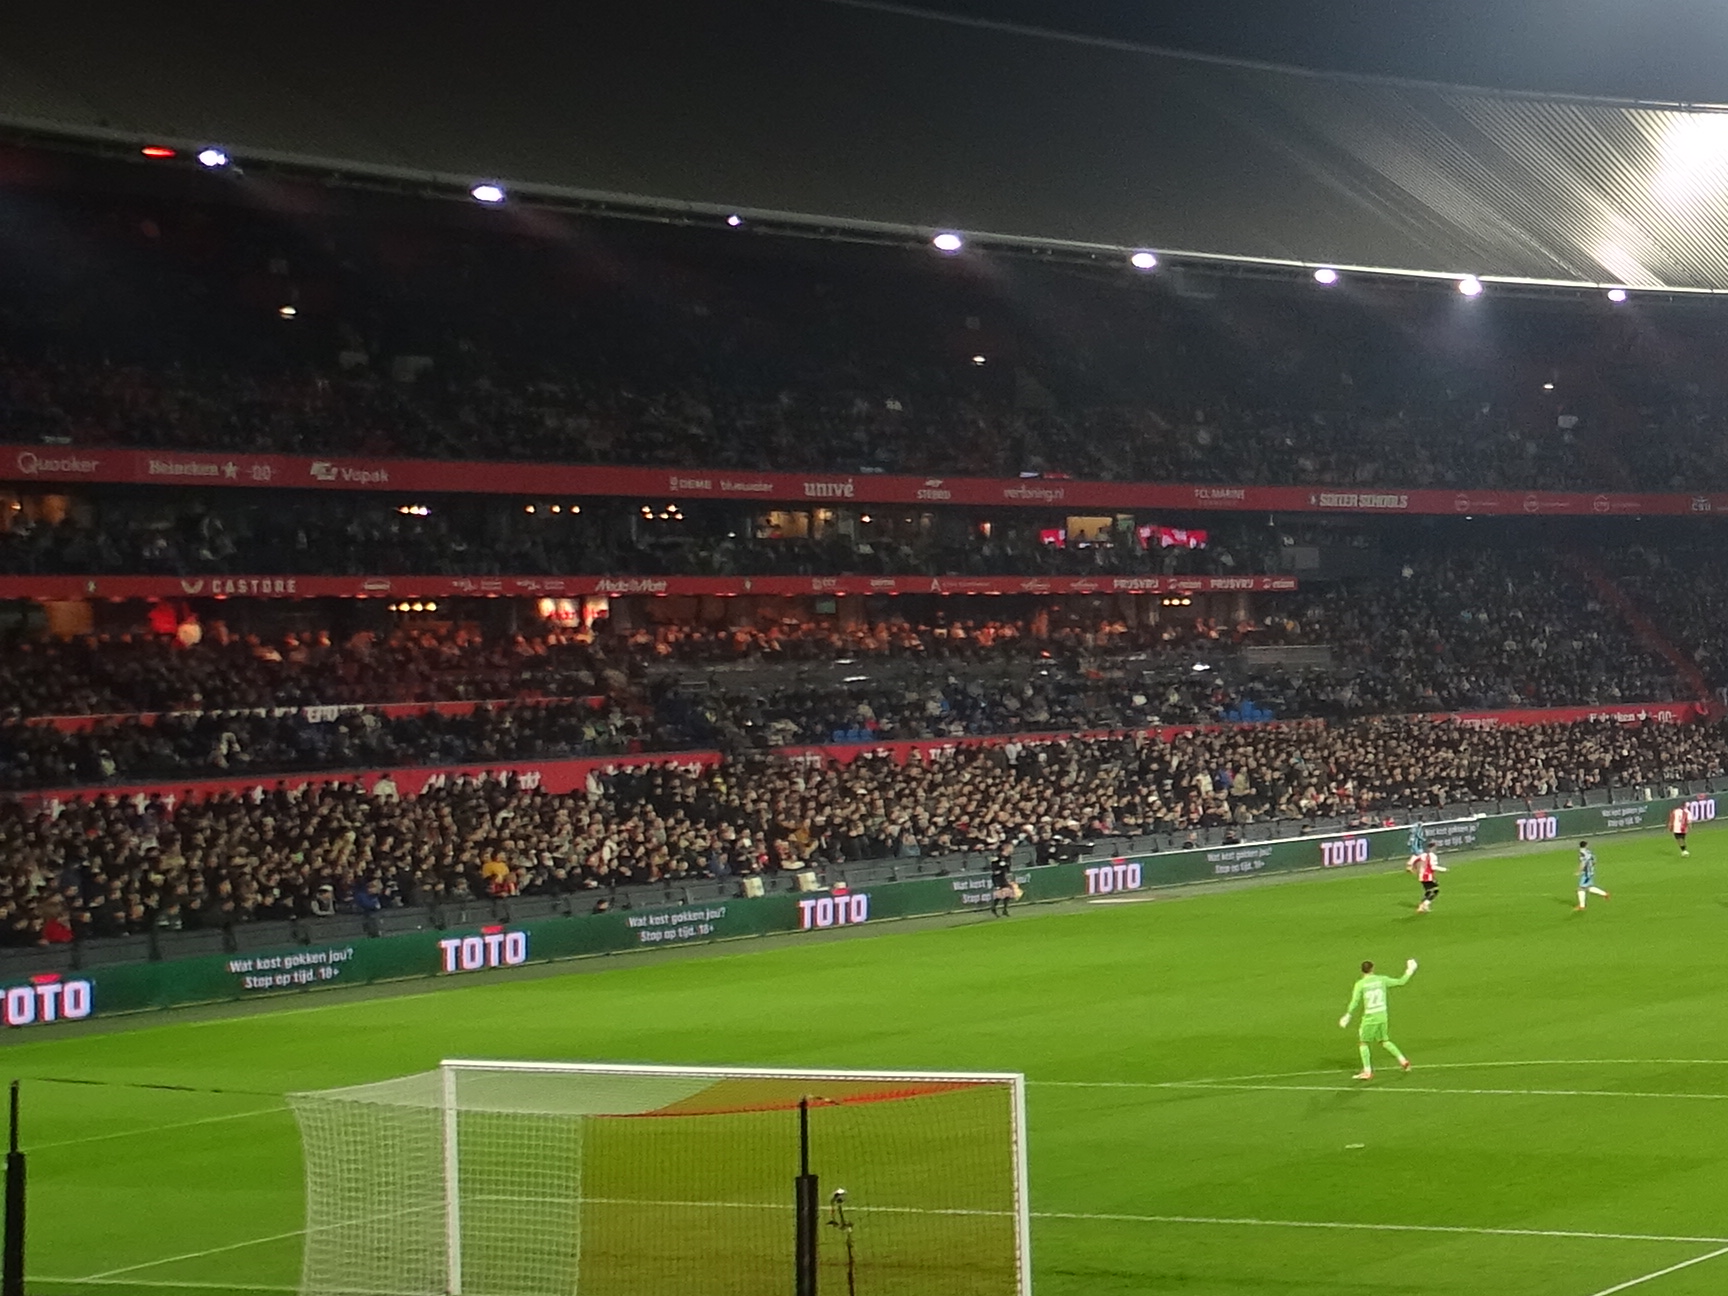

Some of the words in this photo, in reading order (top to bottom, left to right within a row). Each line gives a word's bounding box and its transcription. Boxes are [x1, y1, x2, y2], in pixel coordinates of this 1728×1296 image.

[804, 478, 854, 497] univé
[212, 579, 297, 593] CASTORE
[1682, 799, 1715, 822] OTO
[1517, 816, 1557, 841] TOTO
[1321, 838, 1368, 867] TOTO
[1086, 862, 1142, 894] TOTO
[629, 916, 648, 927] Wat
[649, 914, 669, 925] kost
[671, 911, 704, 925] gokken
[705, 907, 727, 921] jou?
[799, 894, 868, 930] TOTO
[641, 930, 662, 942] Stop
[664, 929, 677, 940] op
[230, 960, 253, 973] Wat
[256, 956, 282, 971] kost
[284, 952, 327, 969] gokken
[329, 947, 355, 965] jou?
[439, 932, 527, 972] TOTO
[244, 975, 272, 989] Stop
[275, 973, 291, 986] op
[293, 969, 317, 985] tijd.
[0, 980, 94, 1026] OTO
